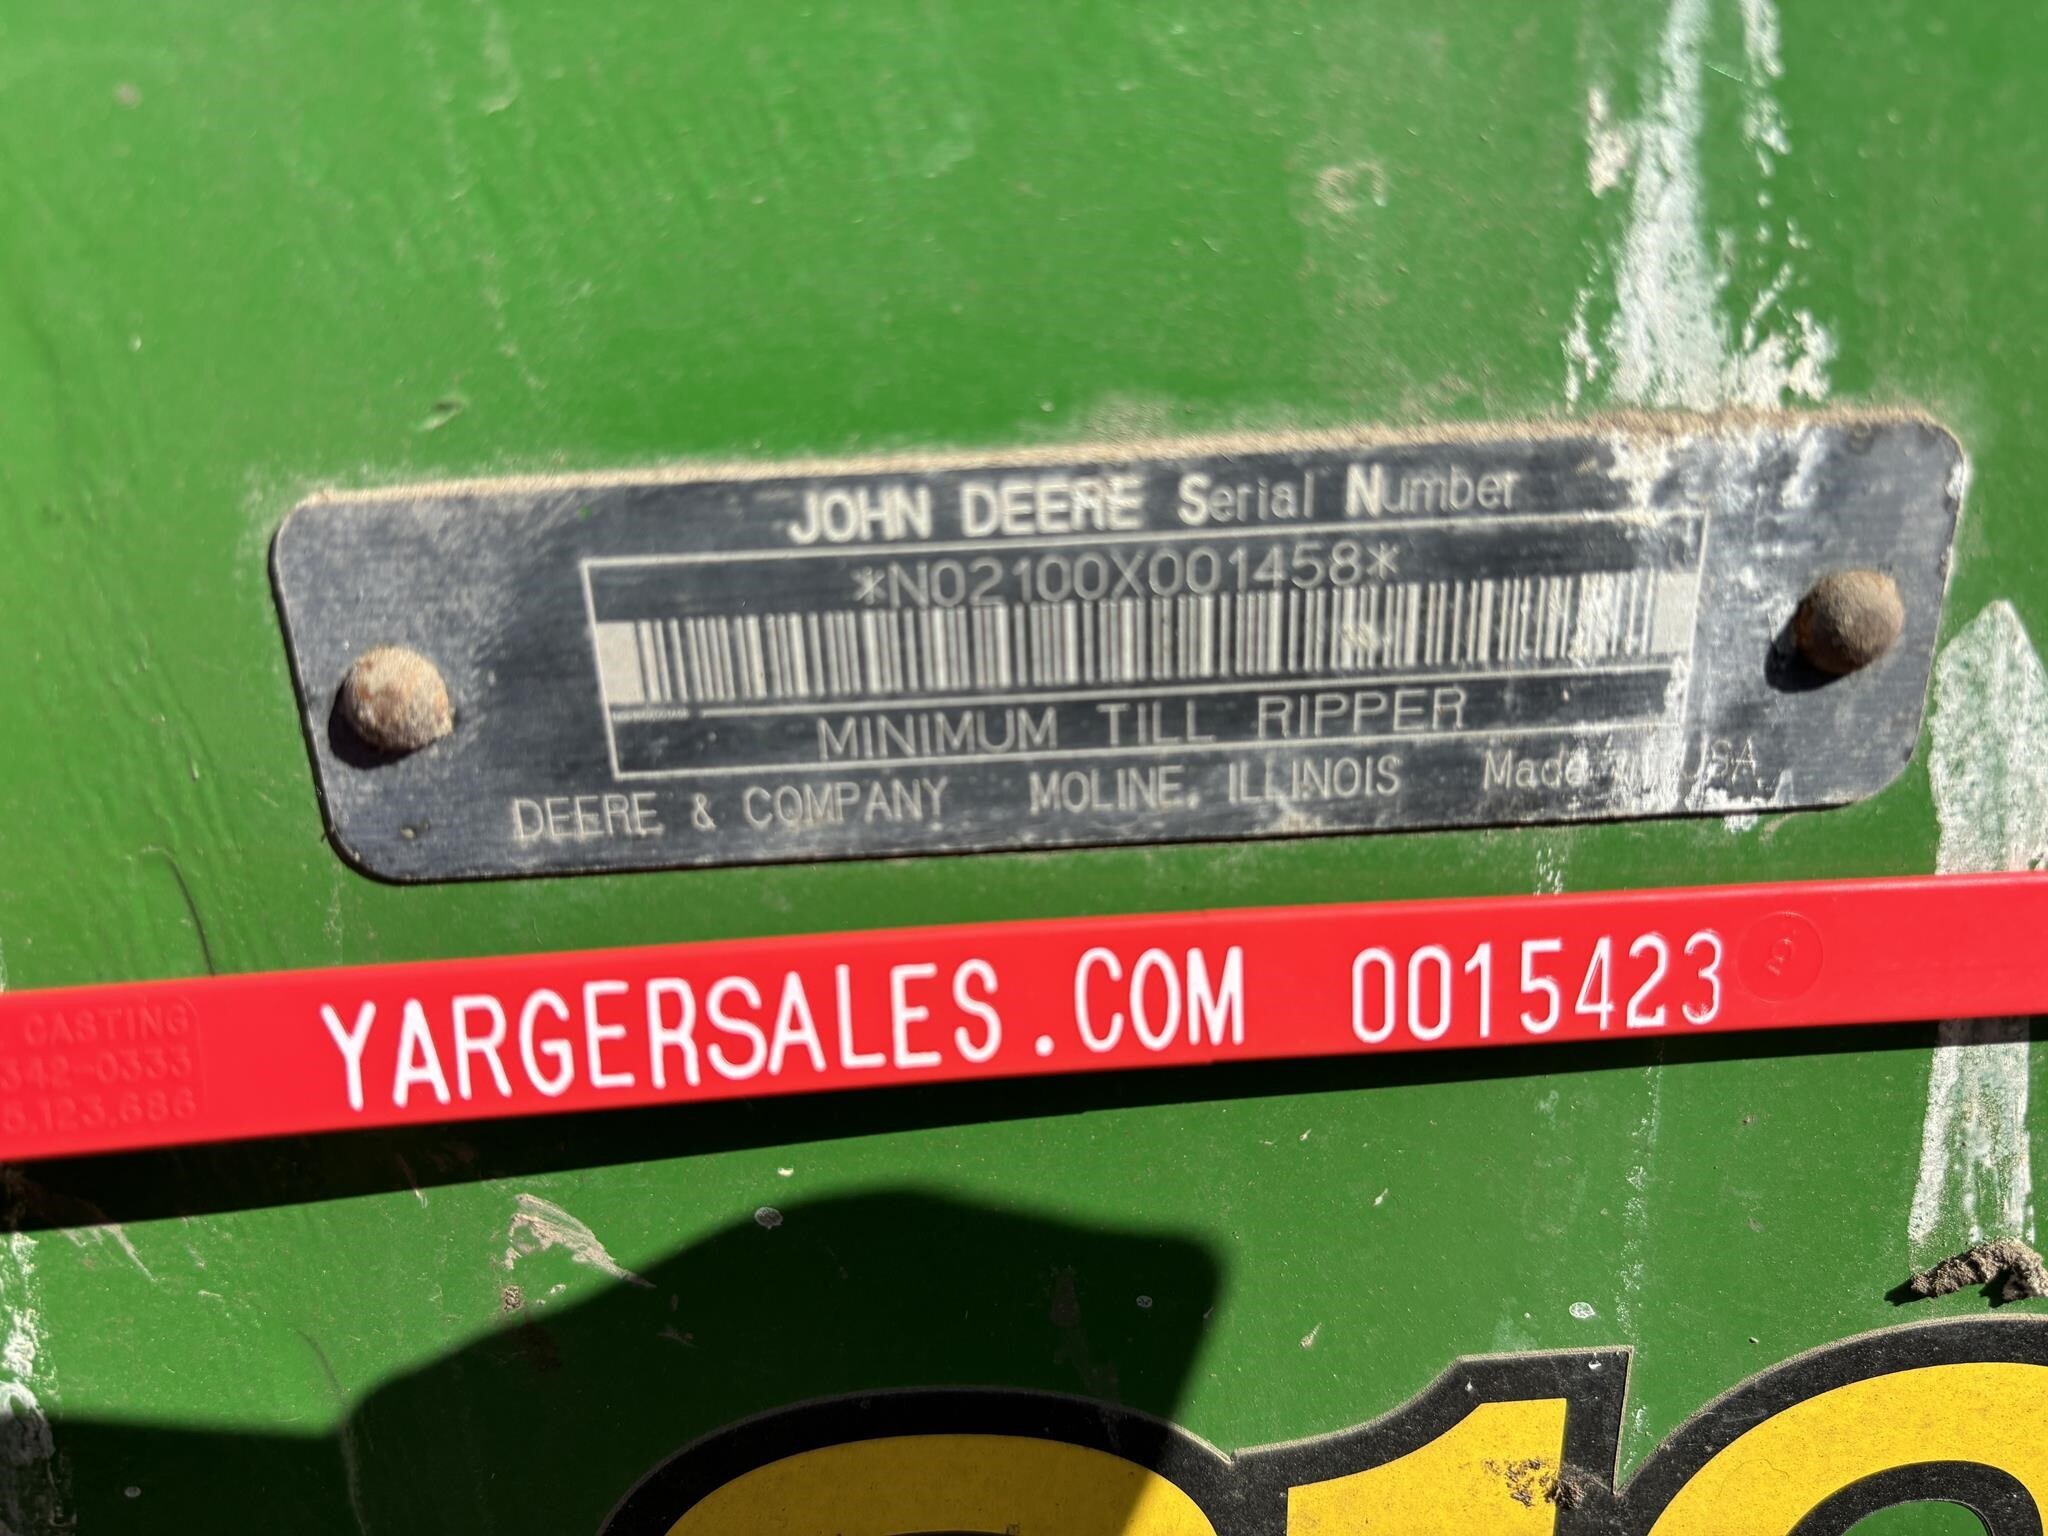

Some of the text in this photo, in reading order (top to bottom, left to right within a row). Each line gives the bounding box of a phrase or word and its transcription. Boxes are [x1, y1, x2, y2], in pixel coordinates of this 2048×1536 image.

[788, 462, 1522, 544] JOHN DEERE Serial Number
[817, 686, 1468, 762] MINIMUM TILL RIPPER
[511, 790, 665, 847] DEERE
[691, 792, 717, 832] &
[742, 776, 949, 830] COMPANY
[1228, 753, 1401, 804] ILLINOIS
[24, 1003, 190, 1047] CASTING
[320, 930, 1726, 1112] YARGERSALES.COM 0015423
